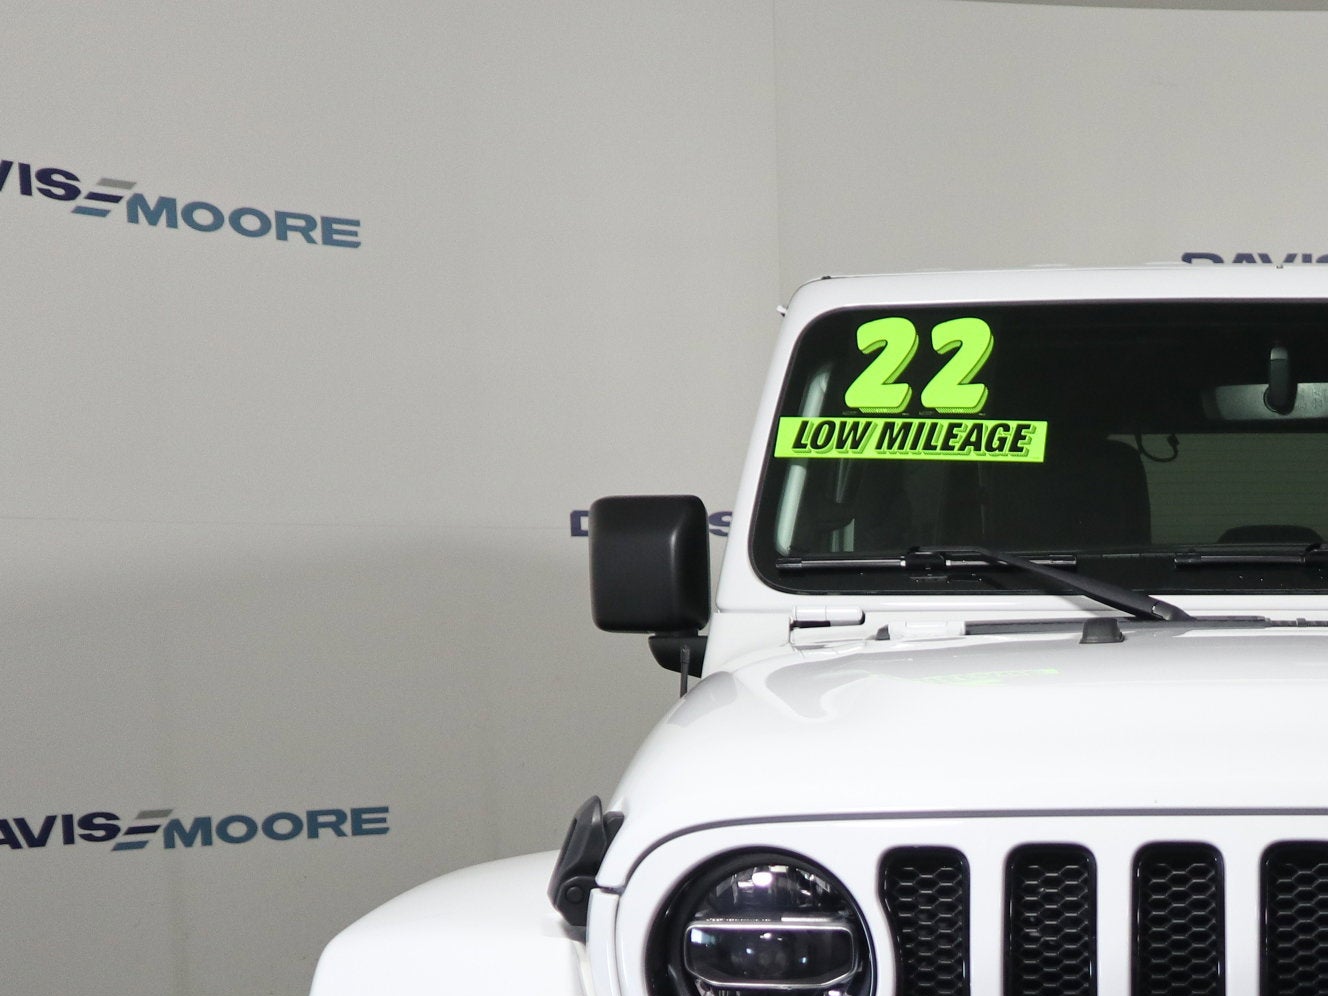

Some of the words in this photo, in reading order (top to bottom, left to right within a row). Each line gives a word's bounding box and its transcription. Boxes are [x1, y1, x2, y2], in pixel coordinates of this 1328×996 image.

[127, 193, 361, 249] MOORE
[844, 316, 994, 413] 22
[792, 420, 876, 453] LOW
[875, 422, 1035, 456] MILEAGE
[163, 806, 390, 850] MOORE
